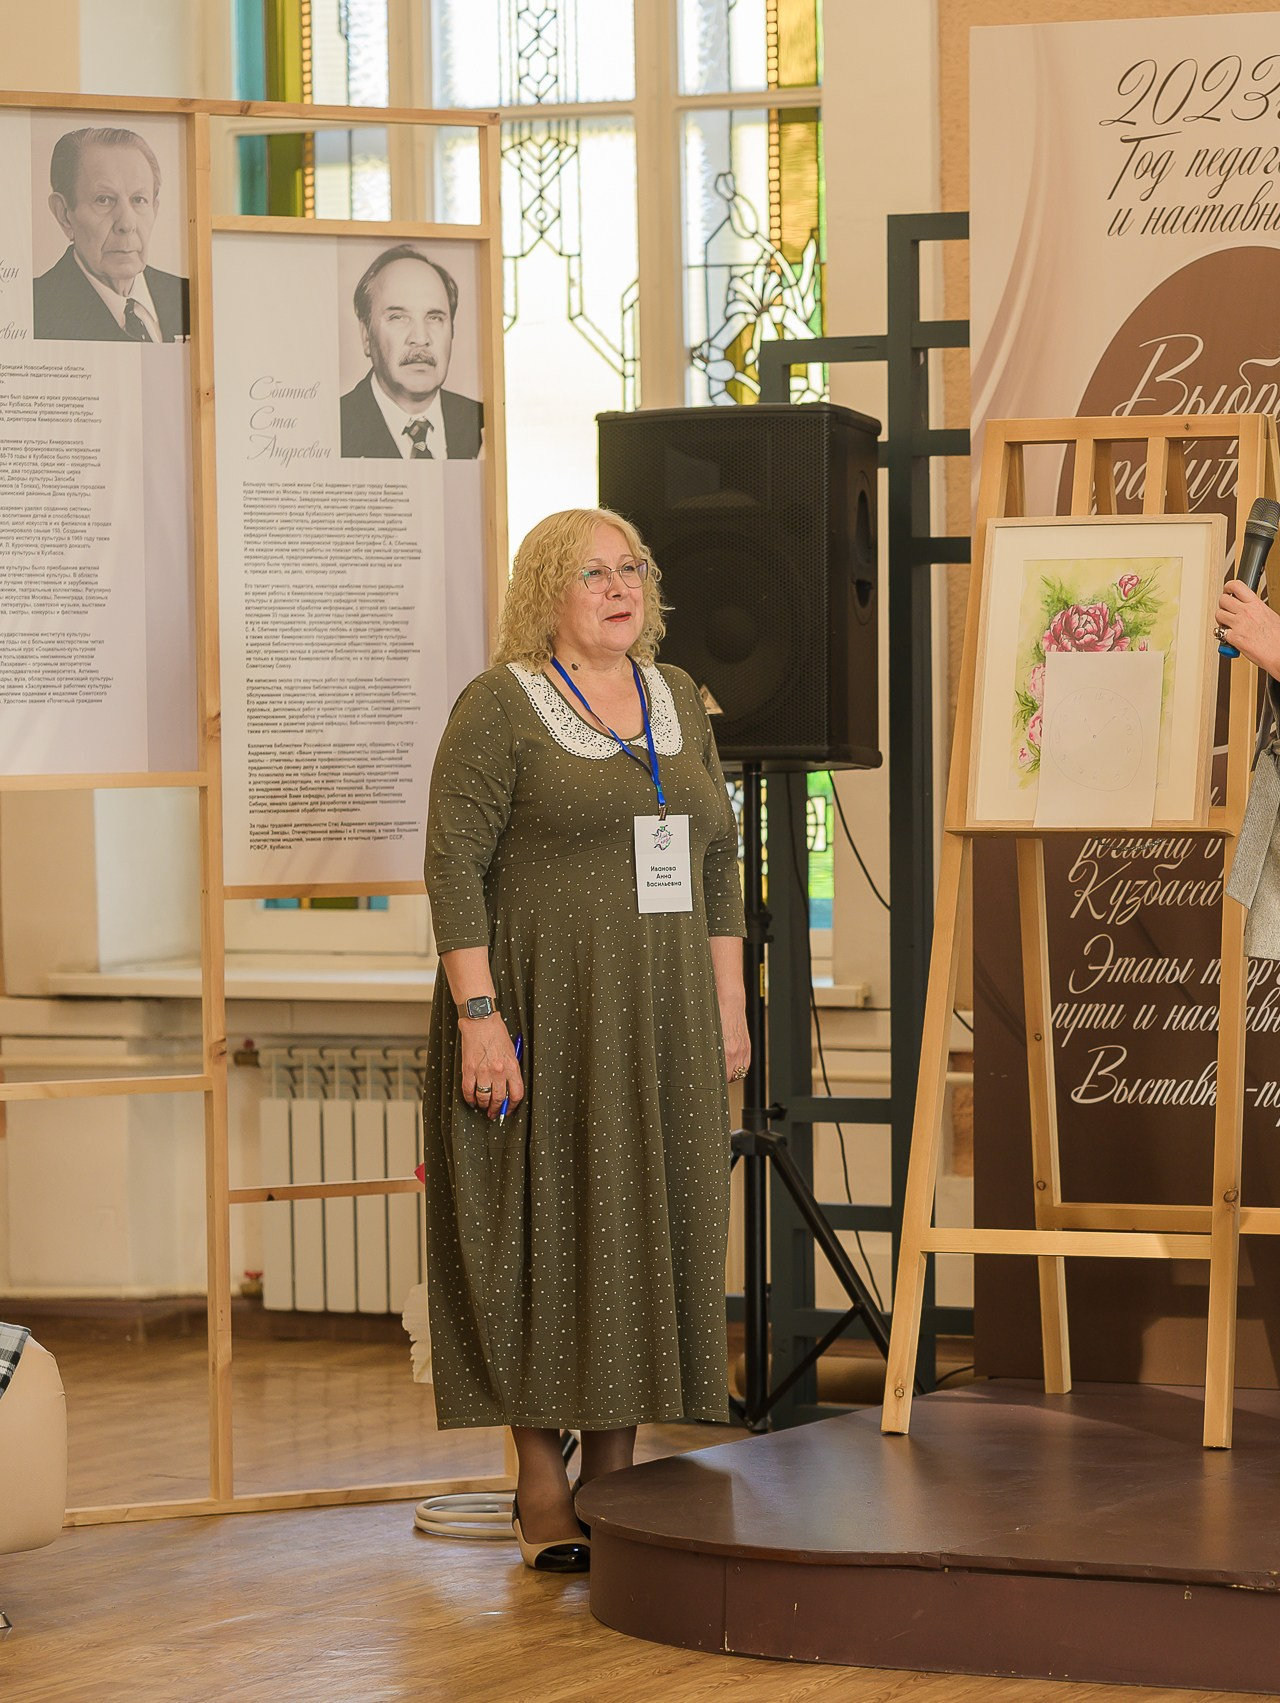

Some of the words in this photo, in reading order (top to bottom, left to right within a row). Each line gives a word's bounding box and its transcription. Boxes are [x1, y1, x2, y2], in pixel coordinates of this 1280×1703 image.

[1108, 206, 1135, 237] и
[250, 405, 298, 430] Стас
[246, 434, 332, 468] Андреевич
[1069, 859, 1225, 926] Кузбасса
[1068, 933, 1195, 994] Этапы
[1051, 1003, 1126, 1047] пути
[1133, 1004, 1158, 1030] и
